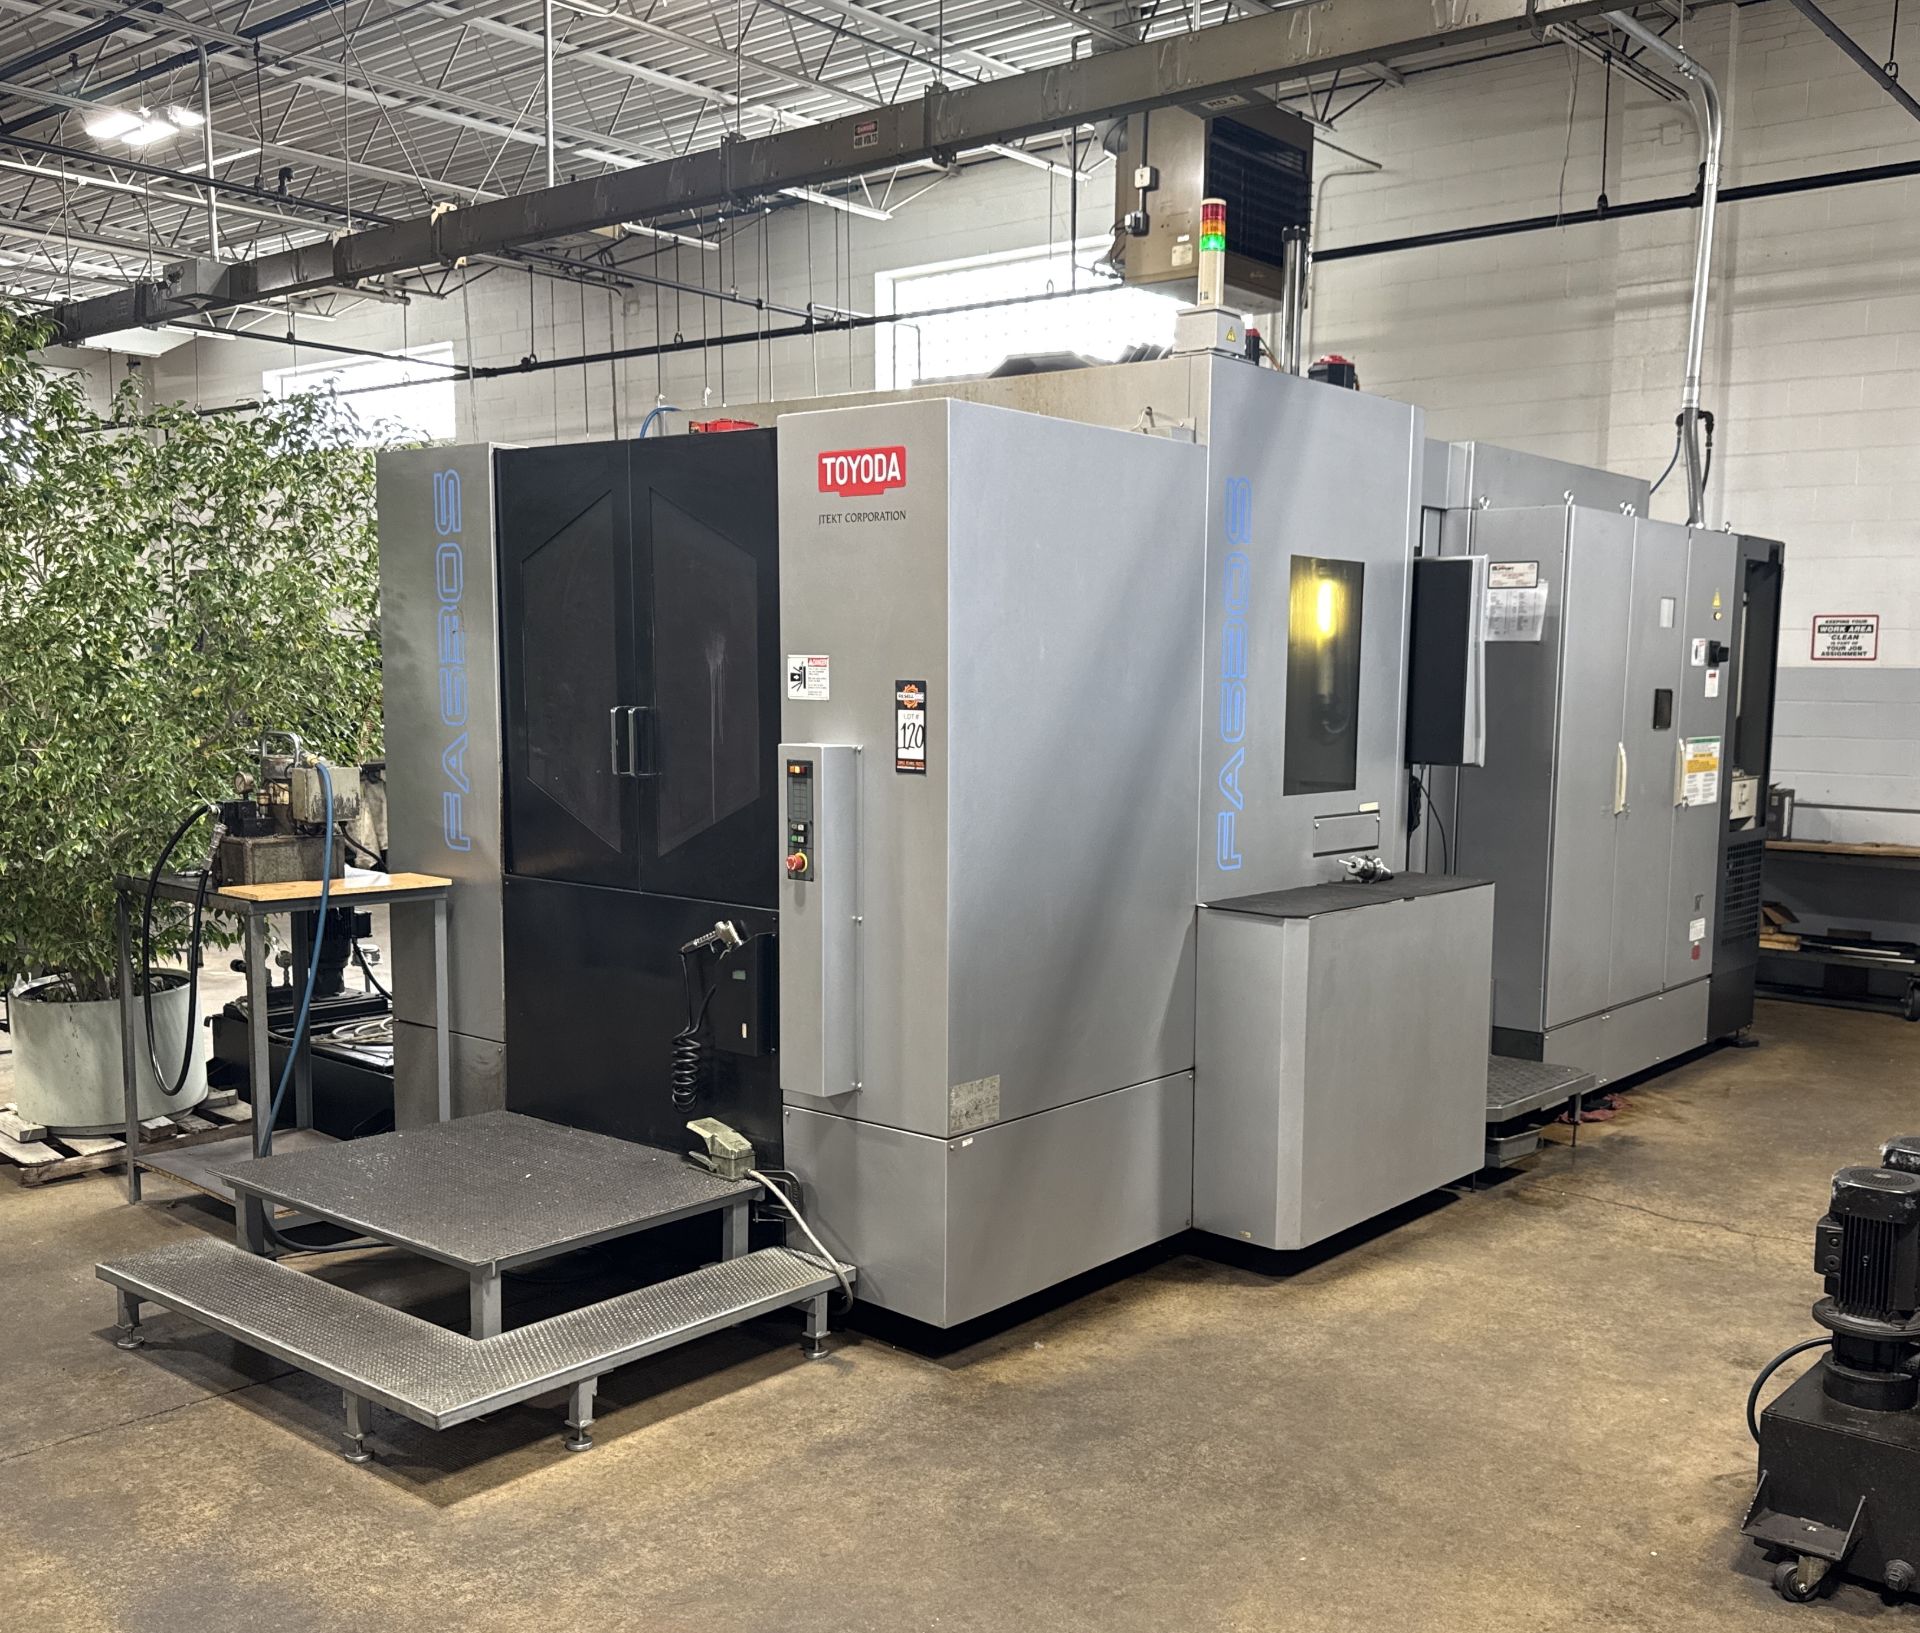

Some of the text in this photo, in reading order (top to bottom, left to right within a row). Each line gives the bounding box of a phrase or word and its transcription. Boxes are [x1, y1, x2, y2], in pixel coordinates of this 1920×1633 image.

[822, 452, 901, 486] TOYODA
[818, 510, 907, 526] JTEKT CORPORATION
[900, 722, 925, 750] 120
